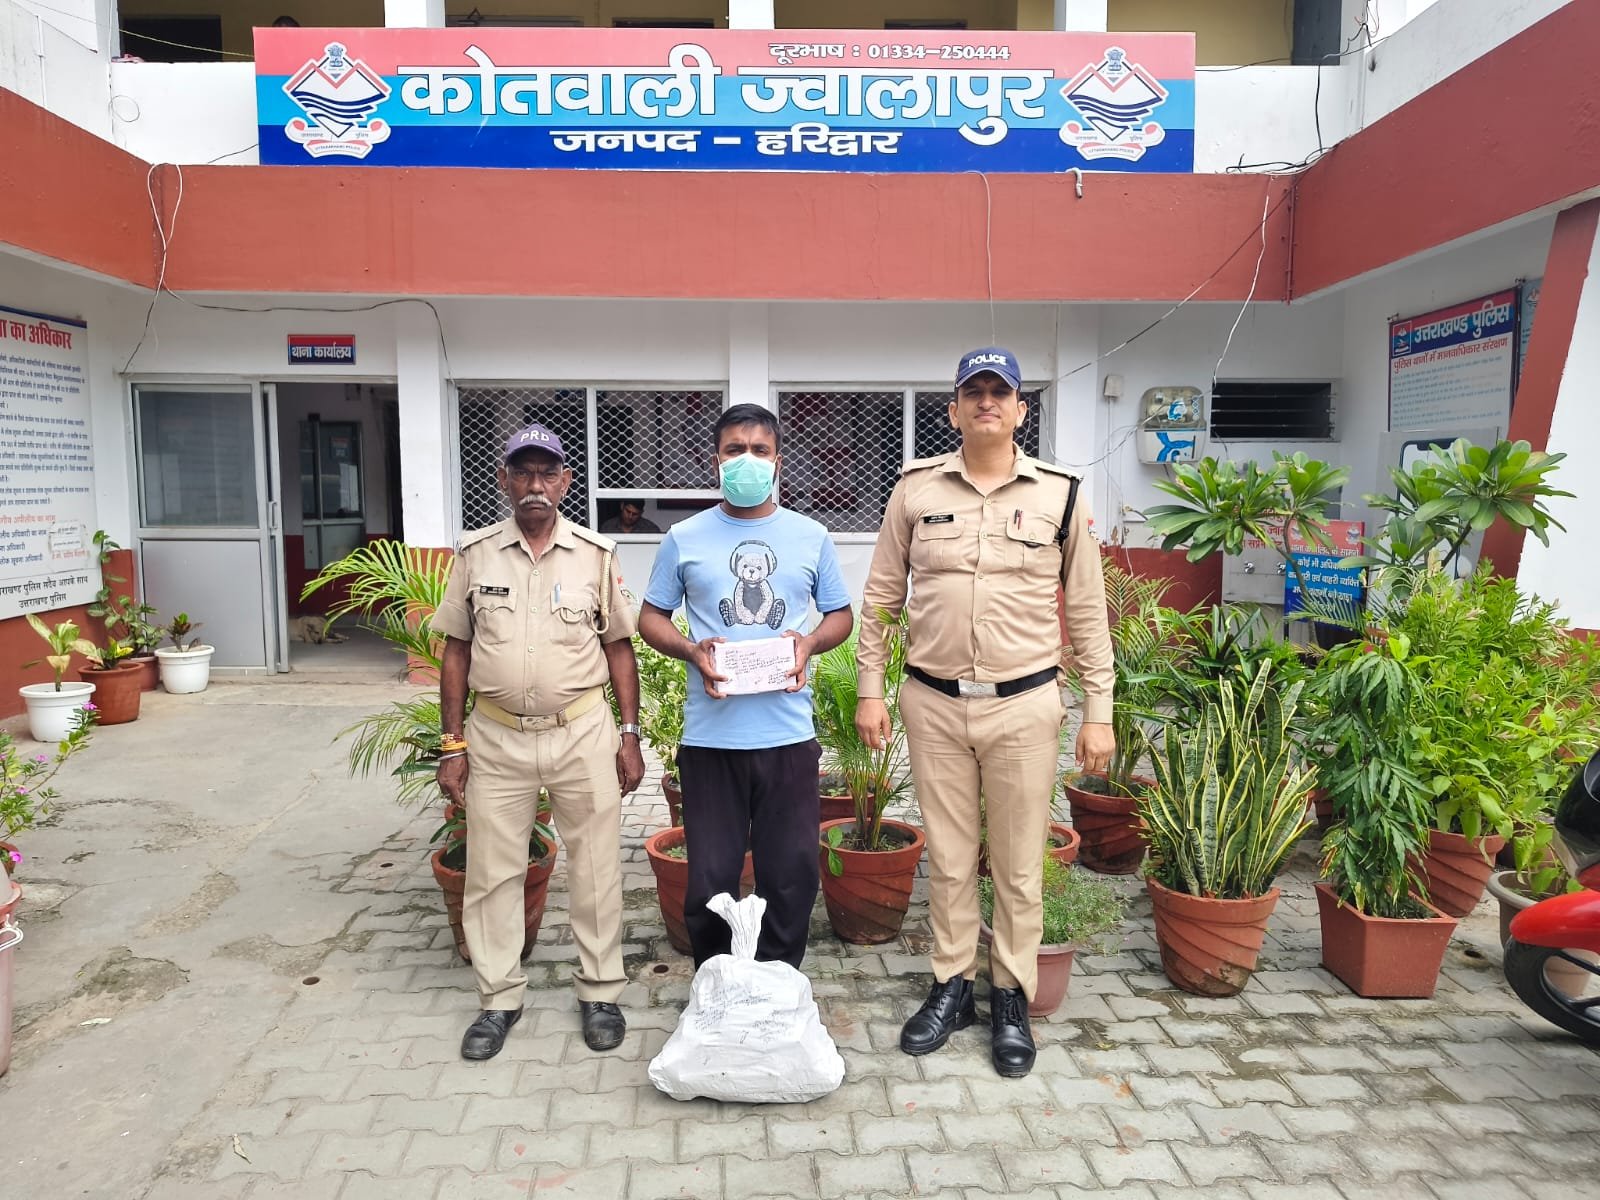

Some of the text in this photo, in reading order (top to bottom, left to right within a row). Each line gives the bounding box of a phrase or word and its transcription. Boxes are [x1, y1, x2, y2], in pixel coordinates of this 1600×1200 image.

[769, 42, 845, 65] दूरभाष
[867, 44, 1011, 61] 01334-250444
[397, 43, 1054, 146] कोतवाली ज्वालापुर
[549, 130, 702, 153] जनपद
[755, 122, 903, 157] हरिद्वार
[1414, 314, 1469, 343] उत्तराखण्ड
[1472, 300, 1511, 339] पुलिस
[9, 321, 26, 342] का
[29, 322, 72, 350] अधिकार
[291, 341, 352, 358] थाना कार्यालय
[968, 353, 1007, 368] POLICE
[520, 430, 550, 443] PRD
[23, 580, 42, 596] पुलिस
[50, 591, 67, 607] पुलिस
